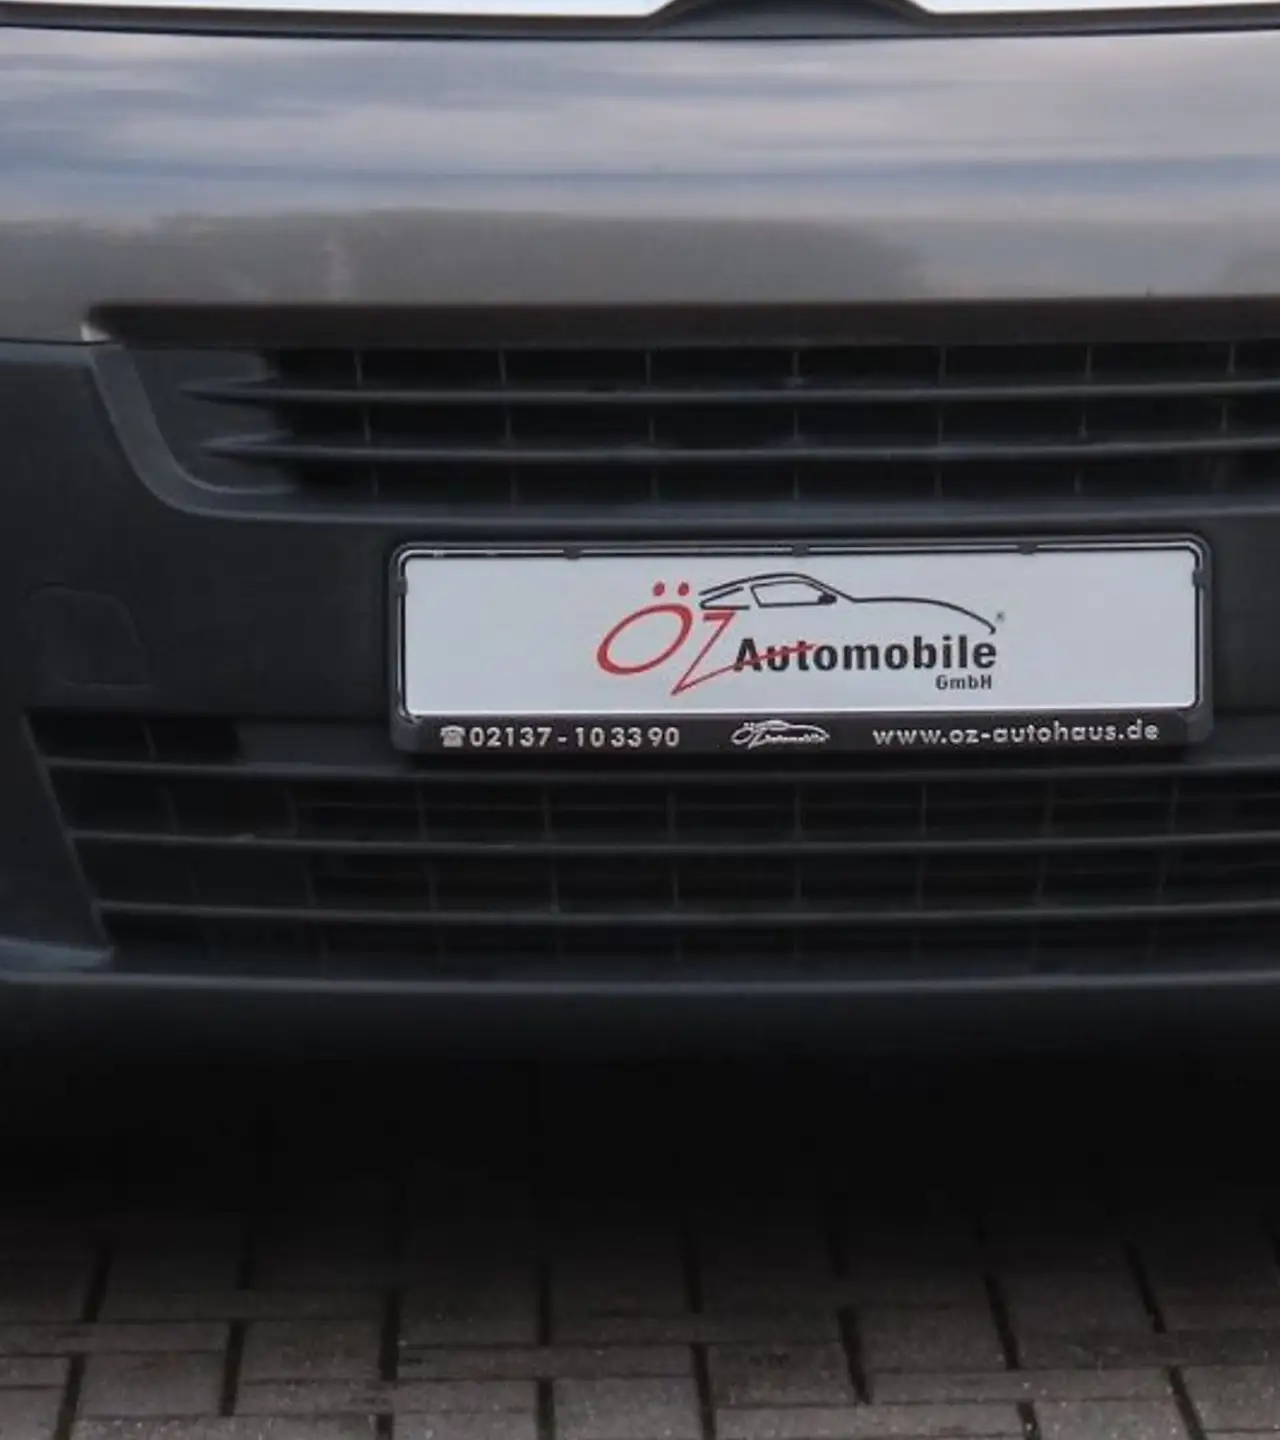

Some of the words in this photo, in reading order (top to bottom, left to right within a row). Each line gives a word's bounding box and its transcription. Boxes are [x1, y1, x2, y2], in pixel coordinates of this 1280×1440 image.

[733, 635, 997, 672] Automobile
[935, 673, 993, 691] GmbH
[872, 719, 1160, 746] www.oz-autohaus.de
